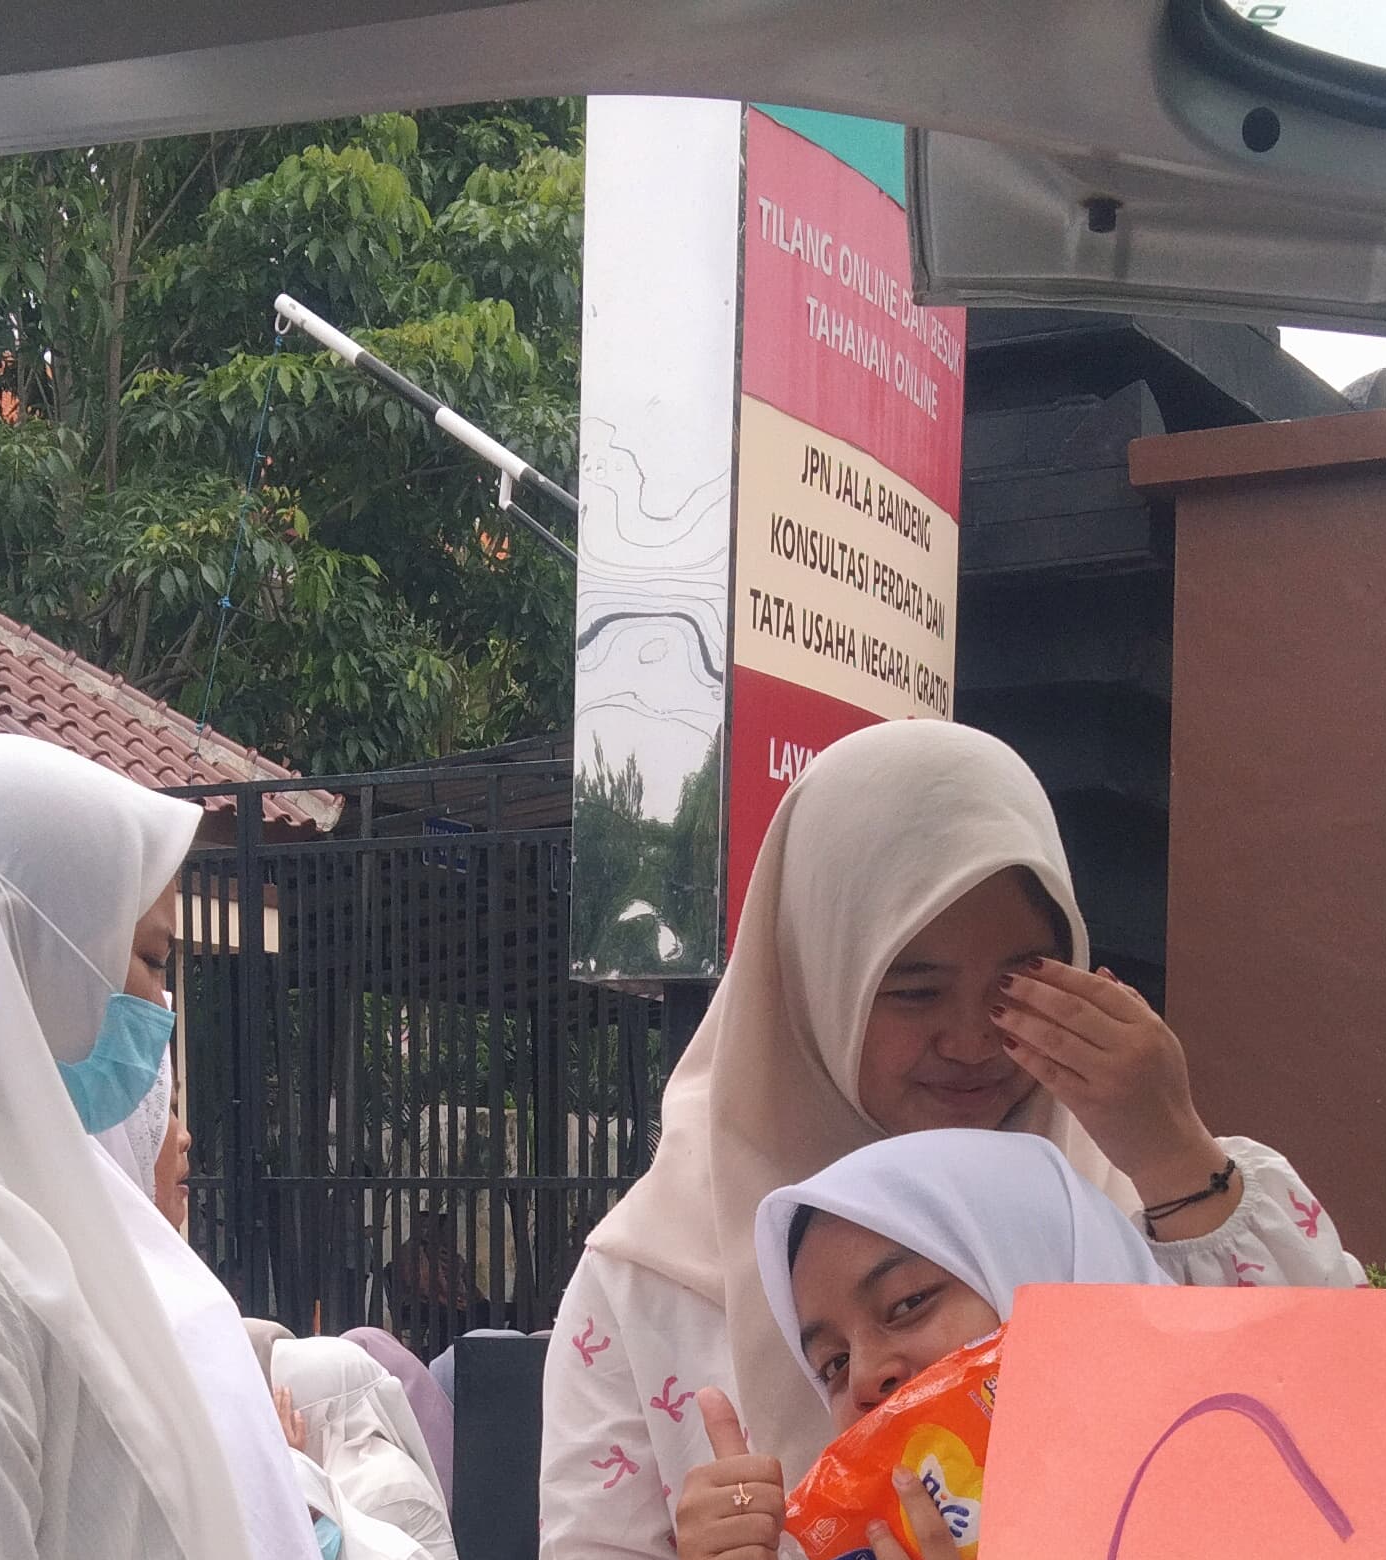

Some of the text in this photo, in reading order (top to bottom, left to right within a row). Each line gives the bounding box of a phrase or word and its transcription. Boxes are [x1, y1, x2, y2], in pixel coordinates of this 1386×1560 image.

[758, 196, 961, 380] TILANG ONLINE DAN BESUK
[806, 295, 938, 421] TAHANAN ONLINE
[801, 444, 931, 552] JPN JALA BANDENG
[770, 512, 945, 640] KONSULTASI PERDATA DAN
[749, 587, 949, 719] TATA USAHA NEGARA (GRATIS)
